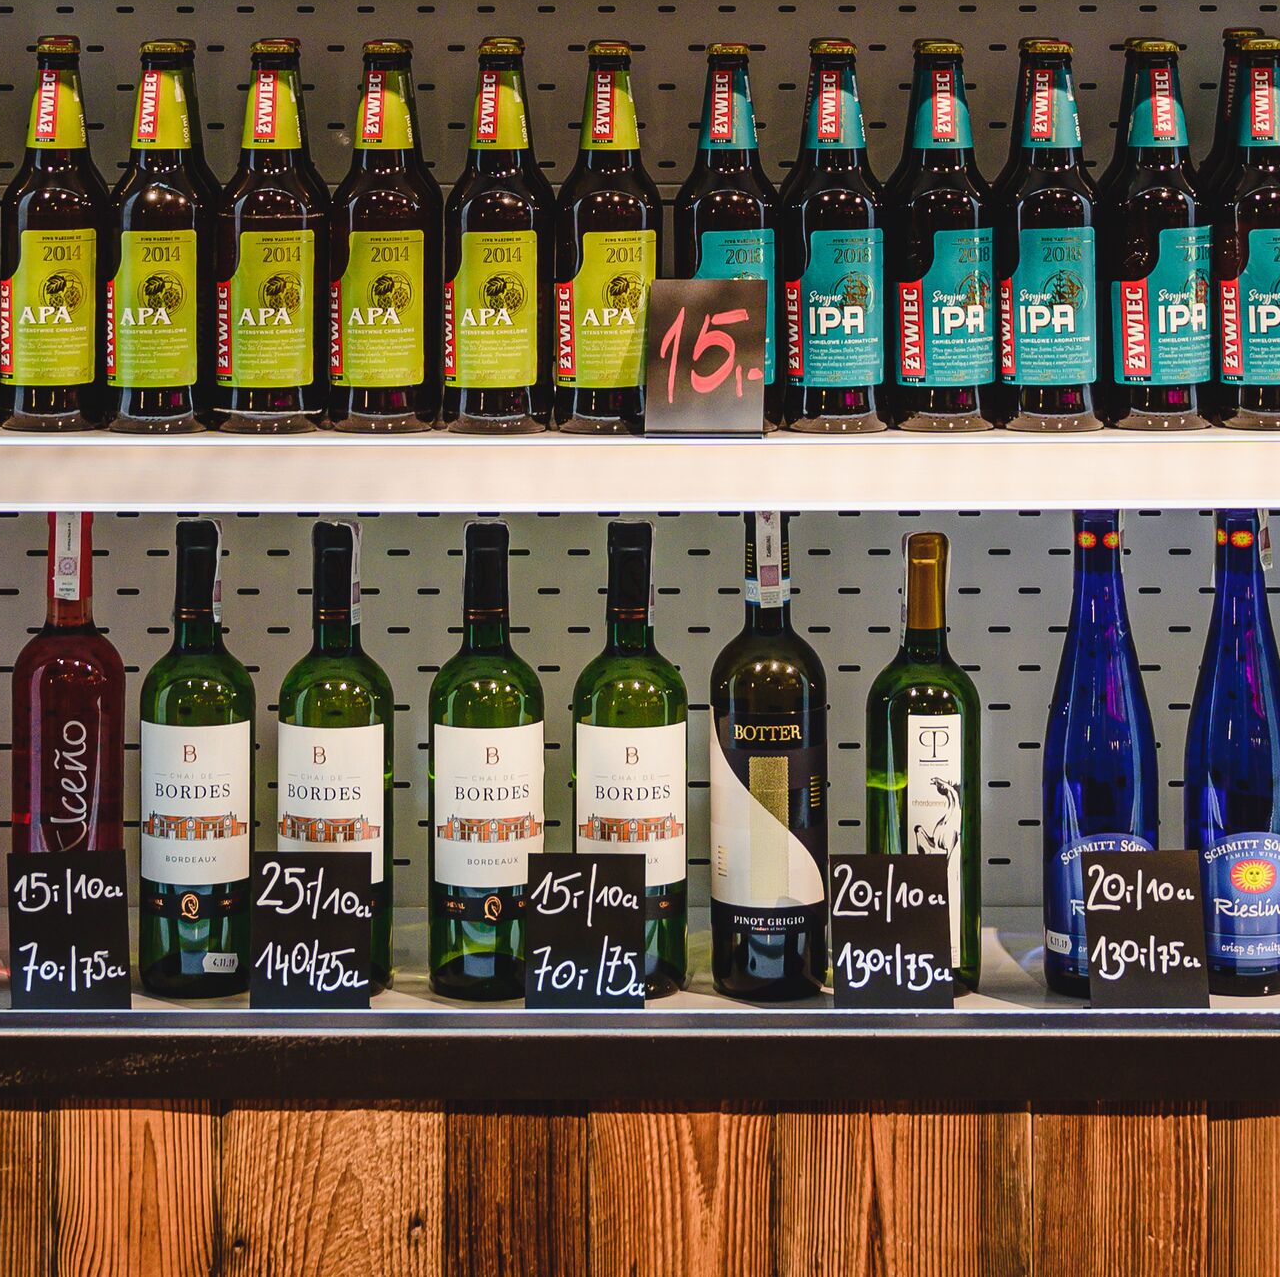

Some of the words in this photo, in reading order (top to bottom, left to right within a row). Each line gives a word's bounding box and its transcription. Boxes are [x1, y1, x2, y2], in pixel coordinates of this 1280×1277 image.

[38, 71, 56, 133] ŻYWIEC
[479, 72, 497, 134] ŻYWIEC
[934, 72, 950, 133] ŻYWIEC
[1253, 70, 1269, 131] ŻYWIEC
[42, 245, 82, 262] 2014
[20, 306, 73, 324] APA
[348, 307, 400, 325] APA
[809, 306, 864, 335] IPA
[1125, 287, 1144, 369] ŻYWIEC
[733, 724, 802, 741] BOTTER
[154, 782, 231, 799] BORDES
[287, 783, 361, 801] BORDES
[455, 784, 530, 801] BORDES
[595, 784, 670, 801] BORDES
[165, 855, 217, 863] BORDEAUX
[1060, 840, 1116, 865] SCHMITT
[1204, 839, 1259, 864] SCHMITT
[467, 857, 519, 865] BORDEAUX
[734, 915, 764, 926] PINOT
[767, 915, 805, 926] GRIGIO
[1221, 941, 1245, 955] crisp
